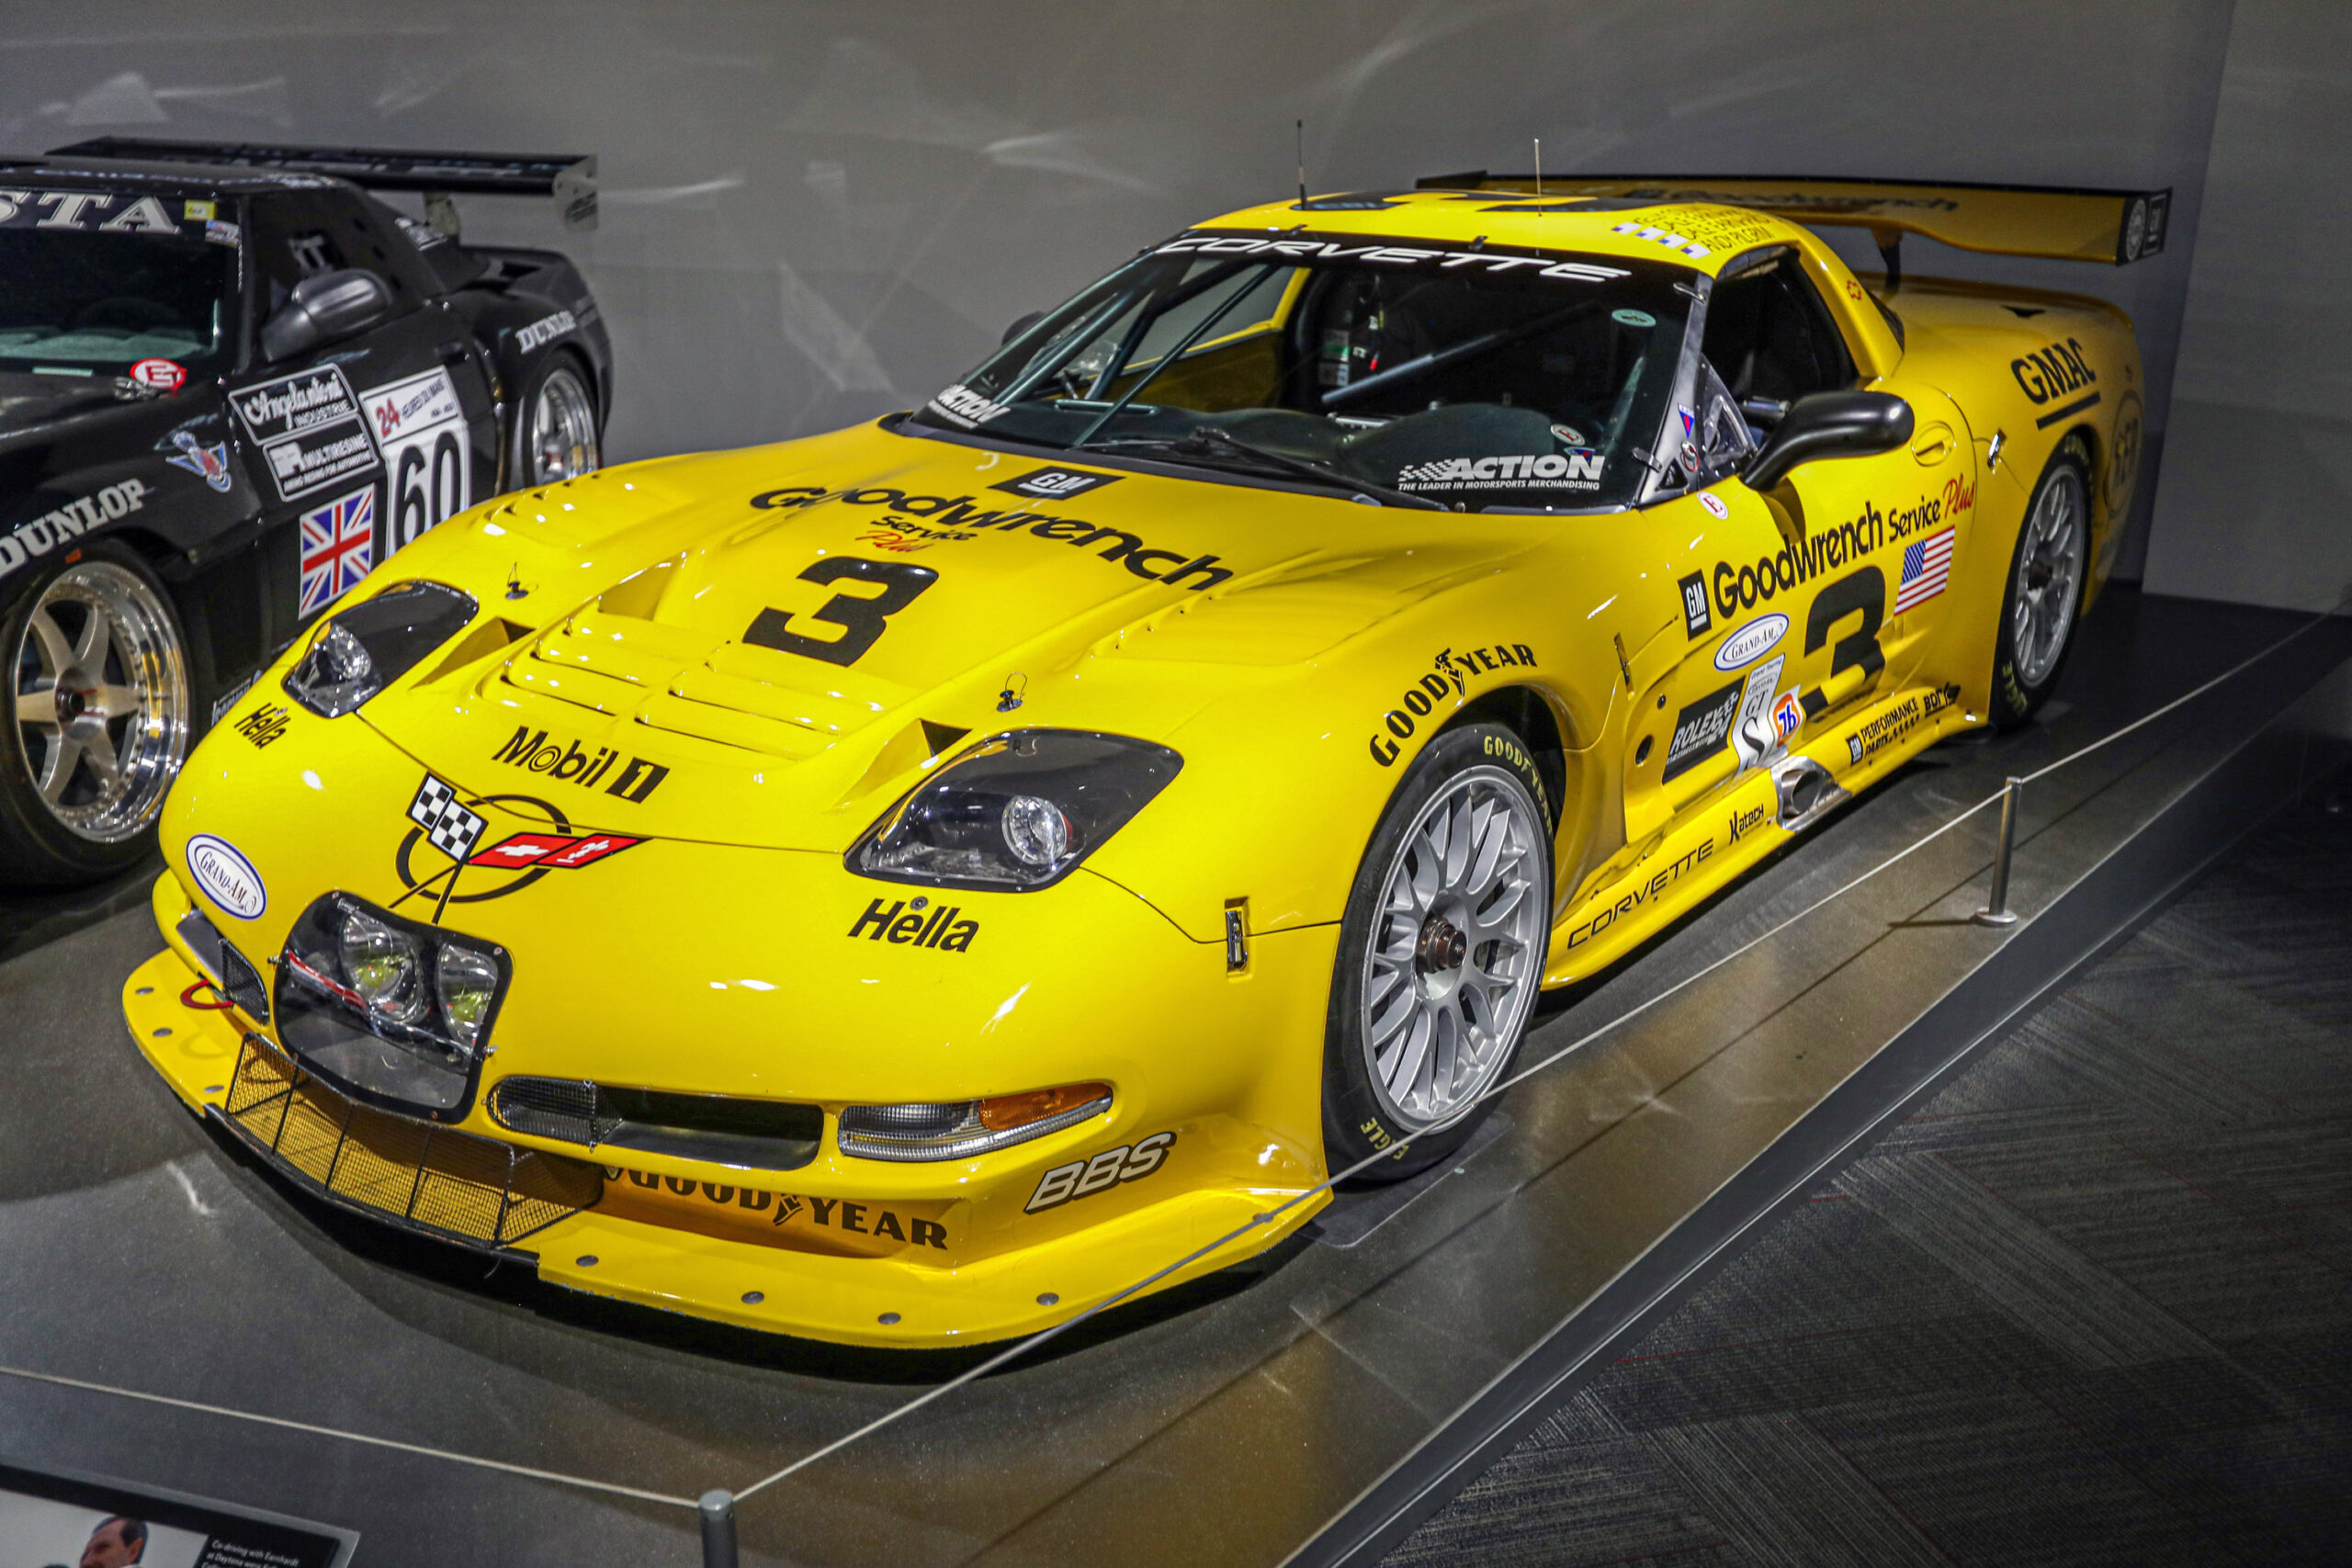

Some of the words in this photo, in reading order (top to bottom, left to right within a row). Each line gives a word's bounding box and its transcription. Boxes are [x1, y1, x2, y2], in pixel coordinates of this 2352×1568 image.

[1154, 238, 1632, 283] CORVETTE
[2010, 337, 2097, 404] GMAC
[375, 397, 400, 438] 24
[395, 429, 460, 552] 60
[1029, 472, 1097, 492] GM
[1418, 482, 1452, 491] LEADER
[1467, 479, 1526, 490] MOTORSPORTS
[1528, 479, 1600, 491] MERCHANDISING
[1434, 455, 1605, 480] ACTION
[0, 478, 145, 579] DUNLOP
[750, 487, 1234, 591] Goodwrench
[870, 515, 978, 541] Service
[1686, 581, 1706, 619] GM
[1713, 501, 1883, 619] Goodwrench
[1889, 495, 1940, 543] Service
[1942, 473, 1975, 520] Plus
[741, 556, 940, 668] 3
[1800, 565, 1886, 719] 3
[233, 703, 291, 750] Hella
[1369, 644, 1538, 768] GOODYEAR
[1669, 705, 1723, 756] ROLEX
[1778, 703, 1797, 738] 76
[1860, 696, 1918, 743] PERFORMANCE
[491, 726, 619, 788] Mobil
[612, 760, 663, 801] 1
[1567, 838, 1713, 950] CORVETTE
[846, 898, 979, 953] Hella
[1361, 1117, 1410, 1160] EGLE
[1025, 1131, 1177, 1215] BBS
